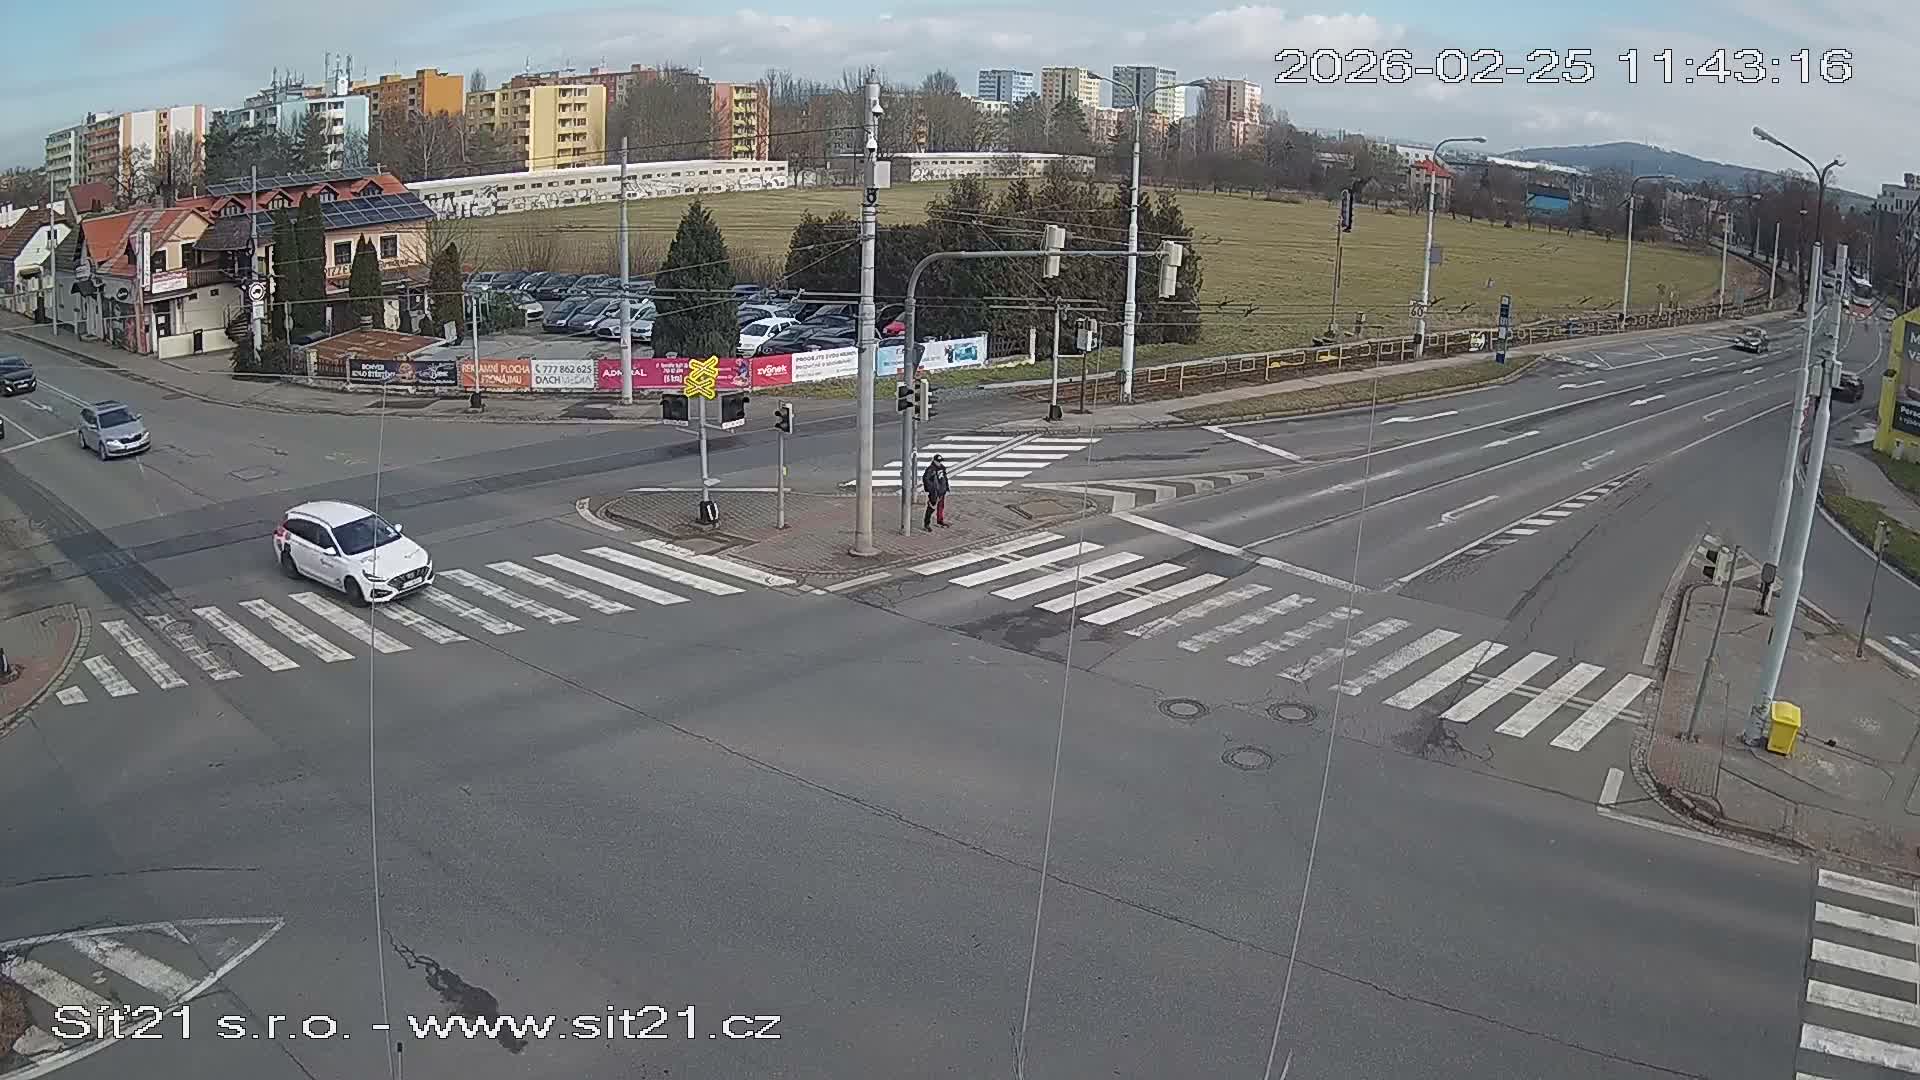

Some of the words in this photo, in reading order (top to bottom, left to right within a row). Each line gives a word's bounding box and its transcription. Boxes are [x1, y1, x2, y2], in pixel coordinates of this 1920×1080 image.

[462, 362, 499, 374] REKAMNÍ
[543, 365, 557, 374] 777
[559, 365, 575, 374] 862
[576, 365, 592, 374] 625
